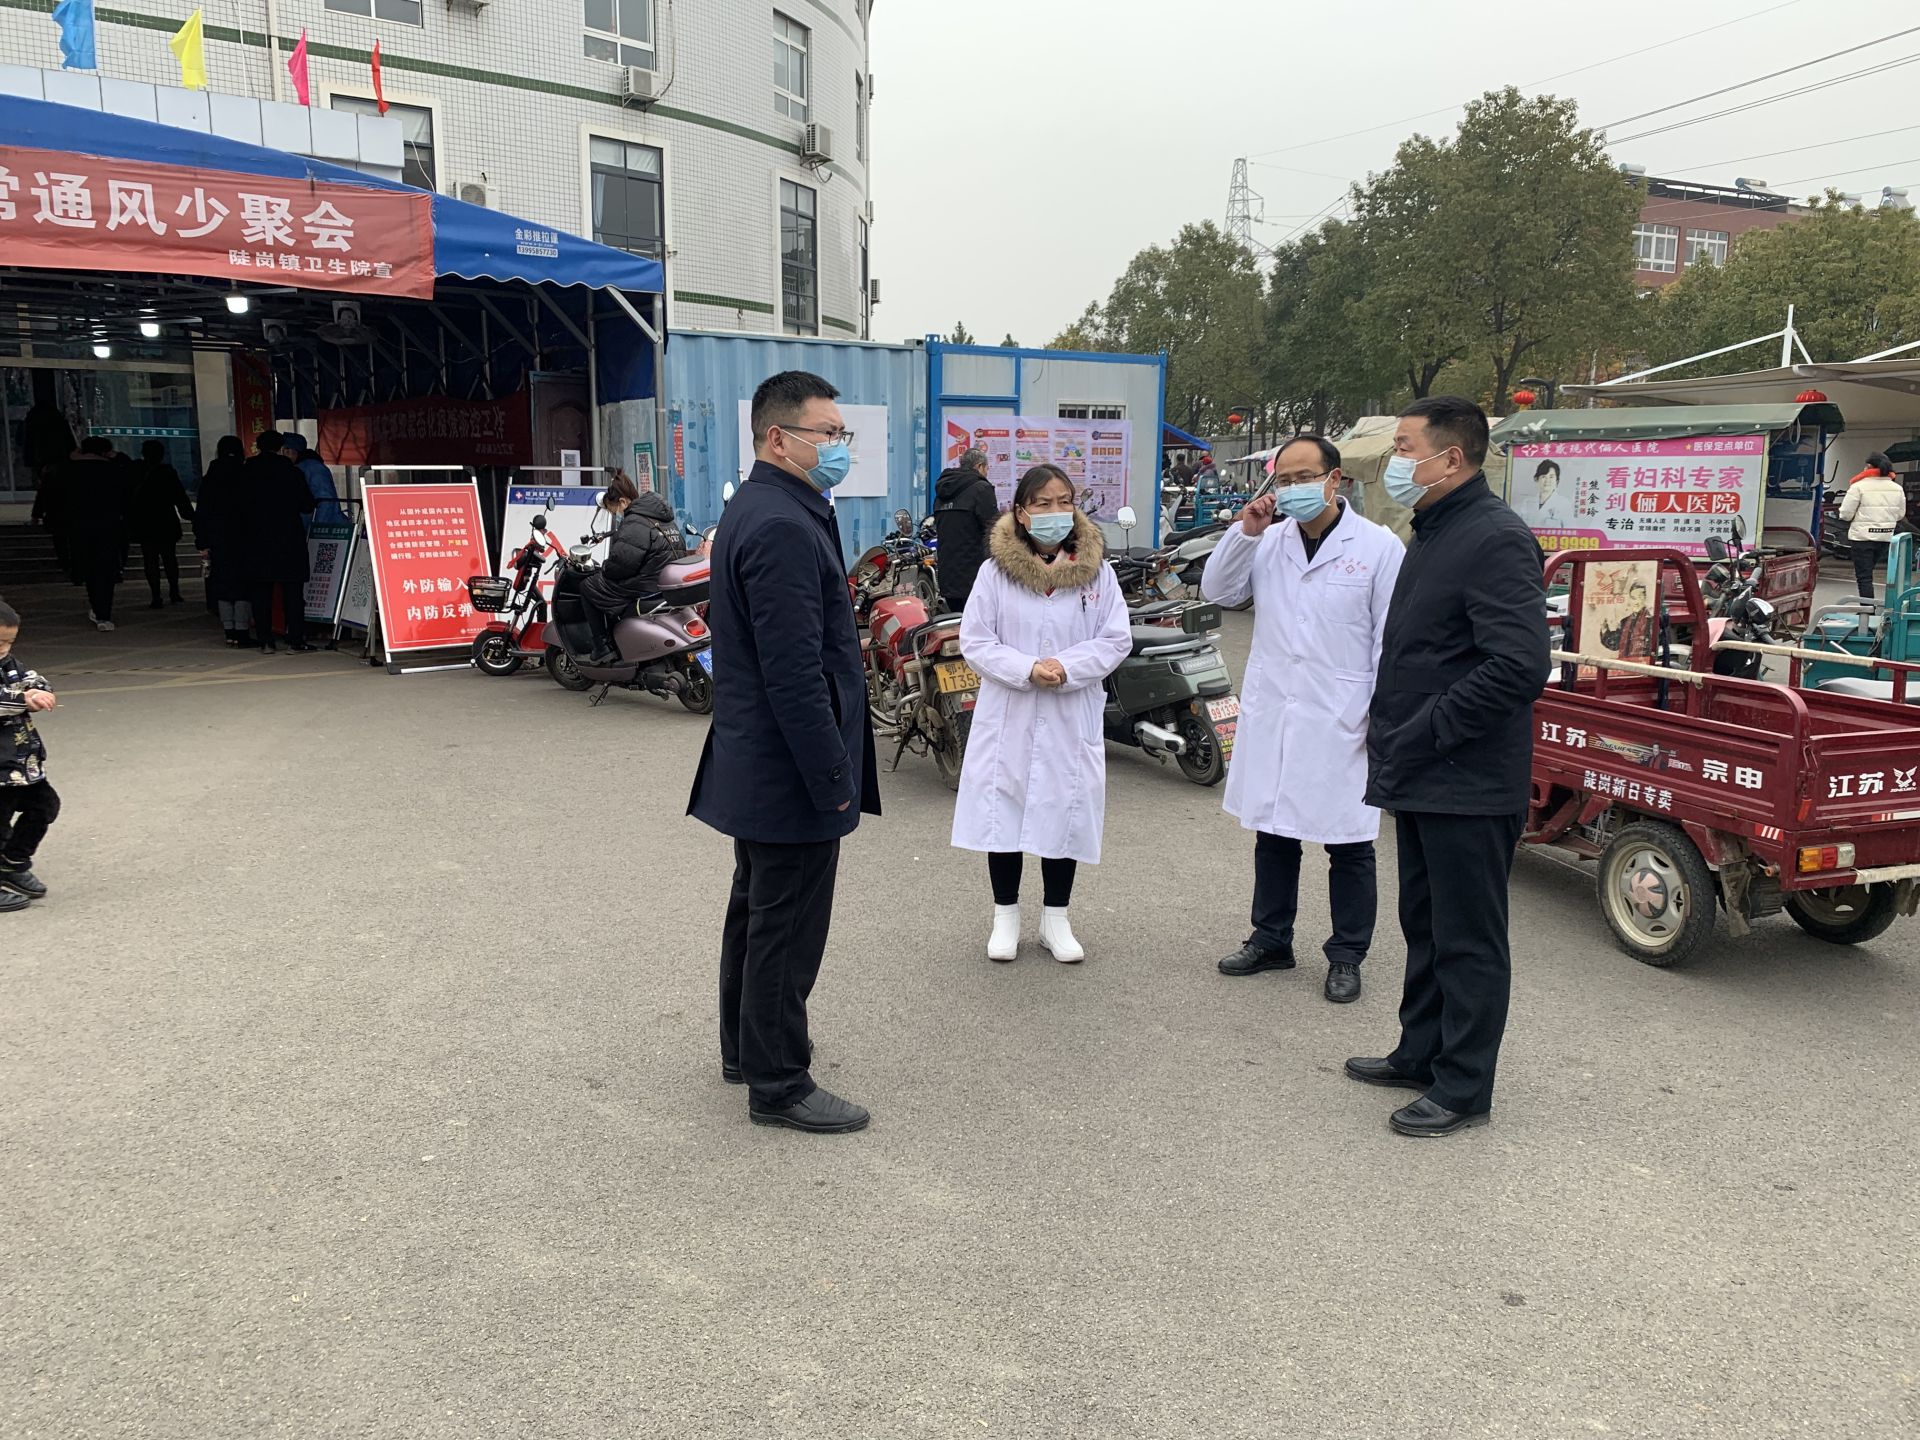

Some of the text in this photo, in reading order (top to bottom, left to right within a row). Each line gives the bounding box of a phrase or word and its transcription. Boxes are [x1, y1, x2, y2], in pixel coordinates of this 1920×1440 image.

[229, 249, 393, 279] 陡岗镇卫生院宣
[1693, 441, 1754, 452] 医保定点单位
[1606, 466, 1745, 489] 看妇科专家
[1636, 493, 1736, 513] 俪人医院
[1605, 517, 1635, 530] 专治
[1560, 536, 1600, 551] 9999
[403, 577, 469, 594] 外防输入
[407, 603, 474, 621] 内防反弹
[1541, 721, 1588, 749] 江苏
[1703, 758, 1764, 790] 宗申
[1583, 770, 1673, 811] 陡岗新日专卖
[1828, 771, 1885, 798] 江苏
